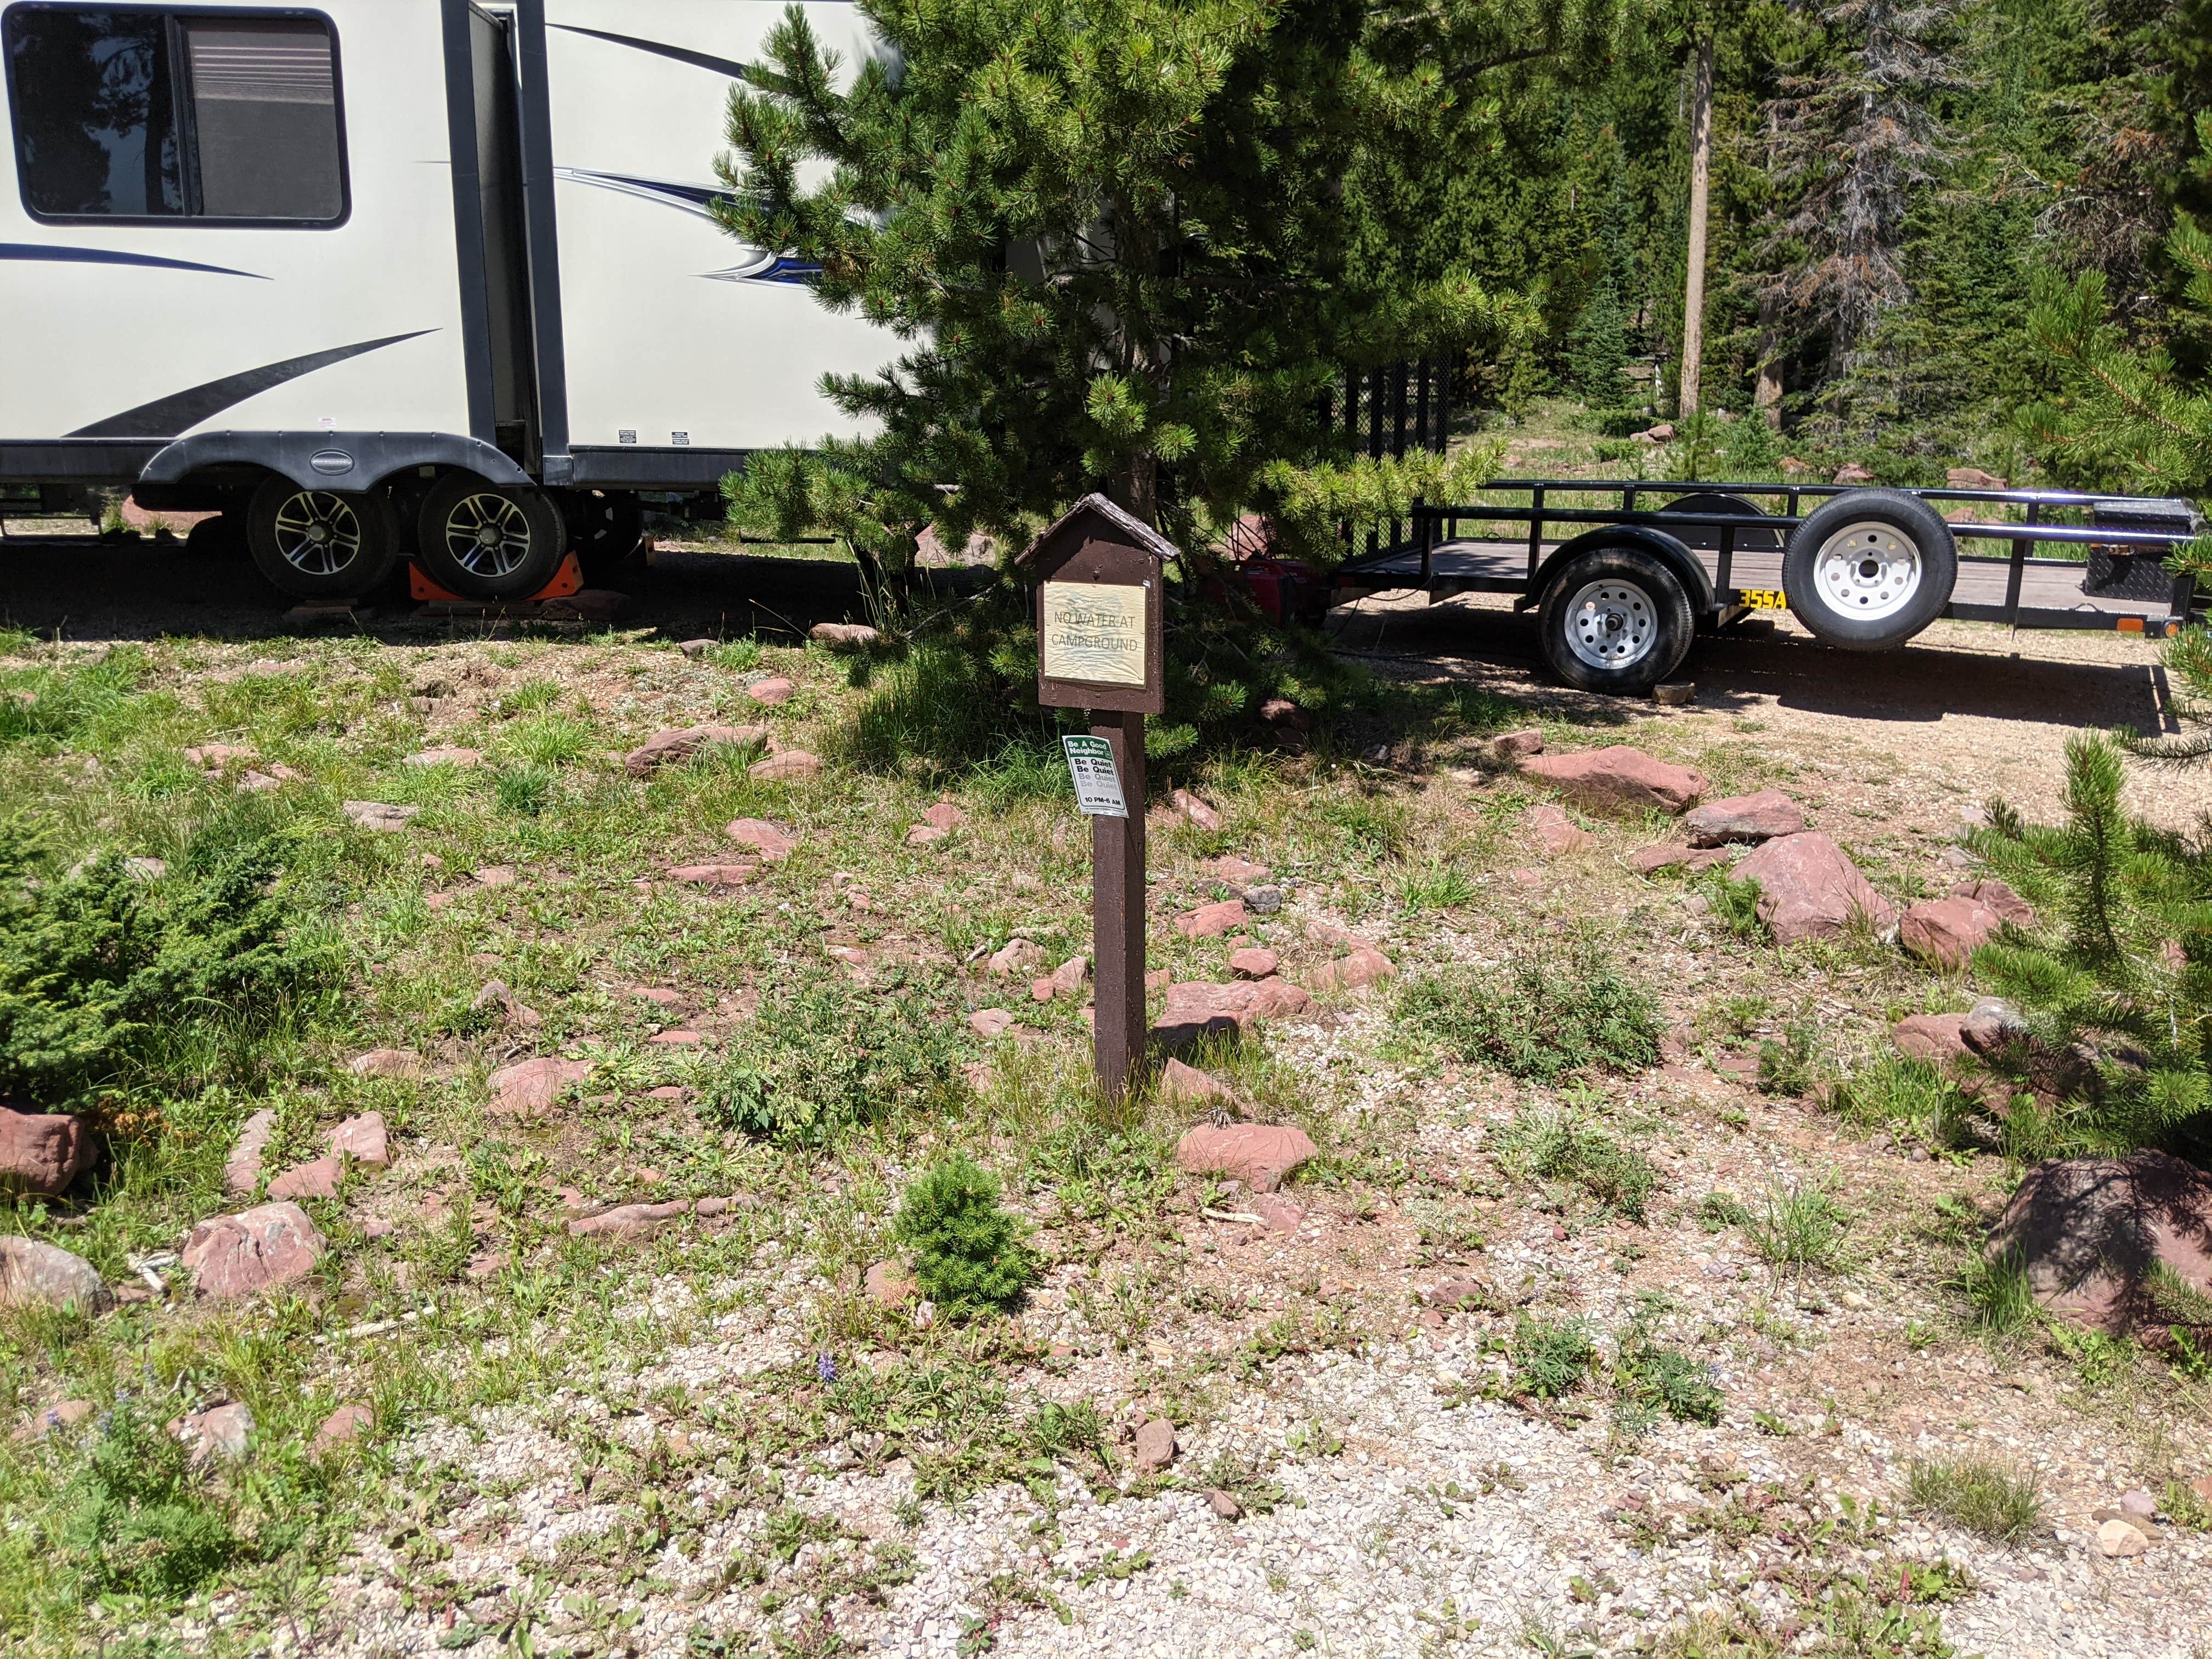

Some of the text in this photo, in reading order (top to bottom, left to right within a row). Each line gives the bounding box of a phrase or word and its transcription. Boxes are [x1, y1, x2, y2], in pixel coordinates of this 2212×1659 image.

[1054, 612, 1136, 628] NO WATER AT
[1052, 634, 1137, 651] CAMPGROUND
[1090, 741, 1107, 750] Good
[1069, 747, 1104, 755] Neighbor
[1091, 758, 1112, 768] Quiet
[1093, 766, 1114, 776] Quiet
[1094, 773, 1116, 783] Quiet
[1096, 780, 1118, 790] Quiet
